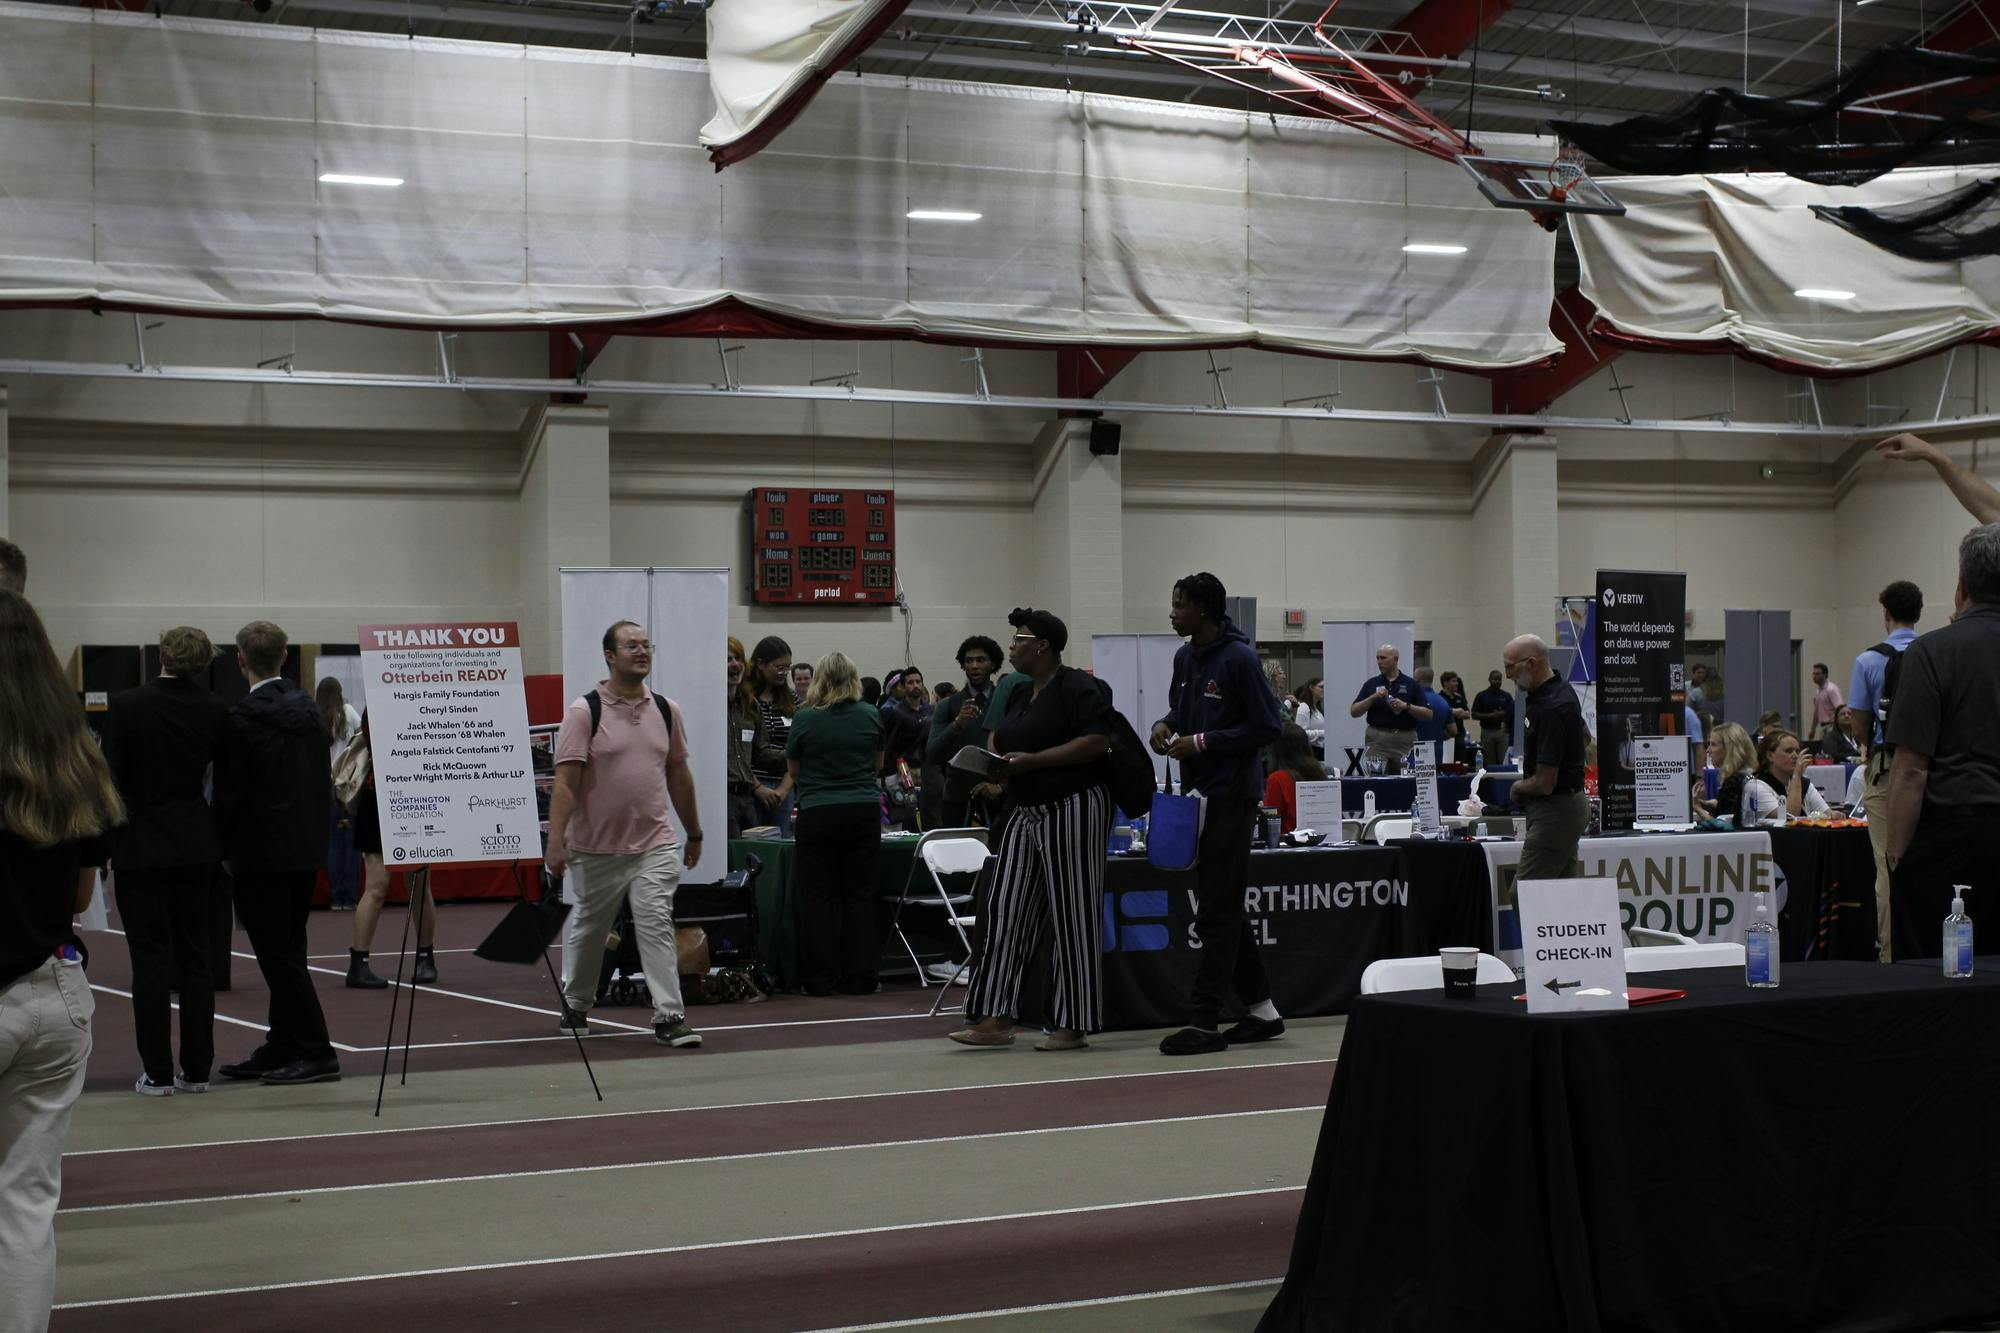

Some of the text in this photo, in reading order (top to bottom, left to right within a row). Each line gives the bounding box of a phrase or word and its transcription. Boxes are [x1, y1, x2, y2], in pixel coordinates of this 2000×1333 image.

[767, 492, 785, 502] fouls
[813, 494, 839, 503] player
[866, 494, 885, 504] fouls
[770, 531, 784, 539] won
[817, 532, 837, 542] game
[766, 549, 788, 560] Home
[815, 587, 840, 598] period
[1618, 594, 1643, 604] VERTIV
[1604, 621, 1674, 635] The world depends
[373, 628, 506, 646] THANK YOU
[1604, 638, 1670, 650] on data we power
[408, 651, 443, 660] following
[1604, 654, 1637, 664] and cool.
[389, 661, 440, 670] organizations
[454, 660, 488, 668] investing
[382, 669, 507, 684] Otterbein READY
[394, 692, 422, 701] Hargis
[424, 691, 450, 700] Family
[420, 706, 447, 715] Cheryl
[407, 722, 426, 731] Jack
[391, 749, 421, 759] Angela
[423, 747, 454, 756] Falstick
[456, 745, 500, 754] Centofanti
[423, 762, 486, 771] Rick McQuown
[386, 774, 411, 783] Porter
[413, 773, 443, 783] Wright
[390, 796, 450, 804] WORTHINGTON
[468, 795, 527, 812] PARKHURST
[391, 811, 443, 819] FOUNDATION
[480, 835, 520, 846] SCIOTO
[410, 847, 452, 858] ellucian
[1187, 879, 1408, 916] RTHINGTON
[1620, 897, 1735, 938] ROUP
[1188, 919, 1277, 949] SEL
[1537, 923, 1607, 938] STUDENT
[1536, 947, 1612, 961] CHECK-IN
